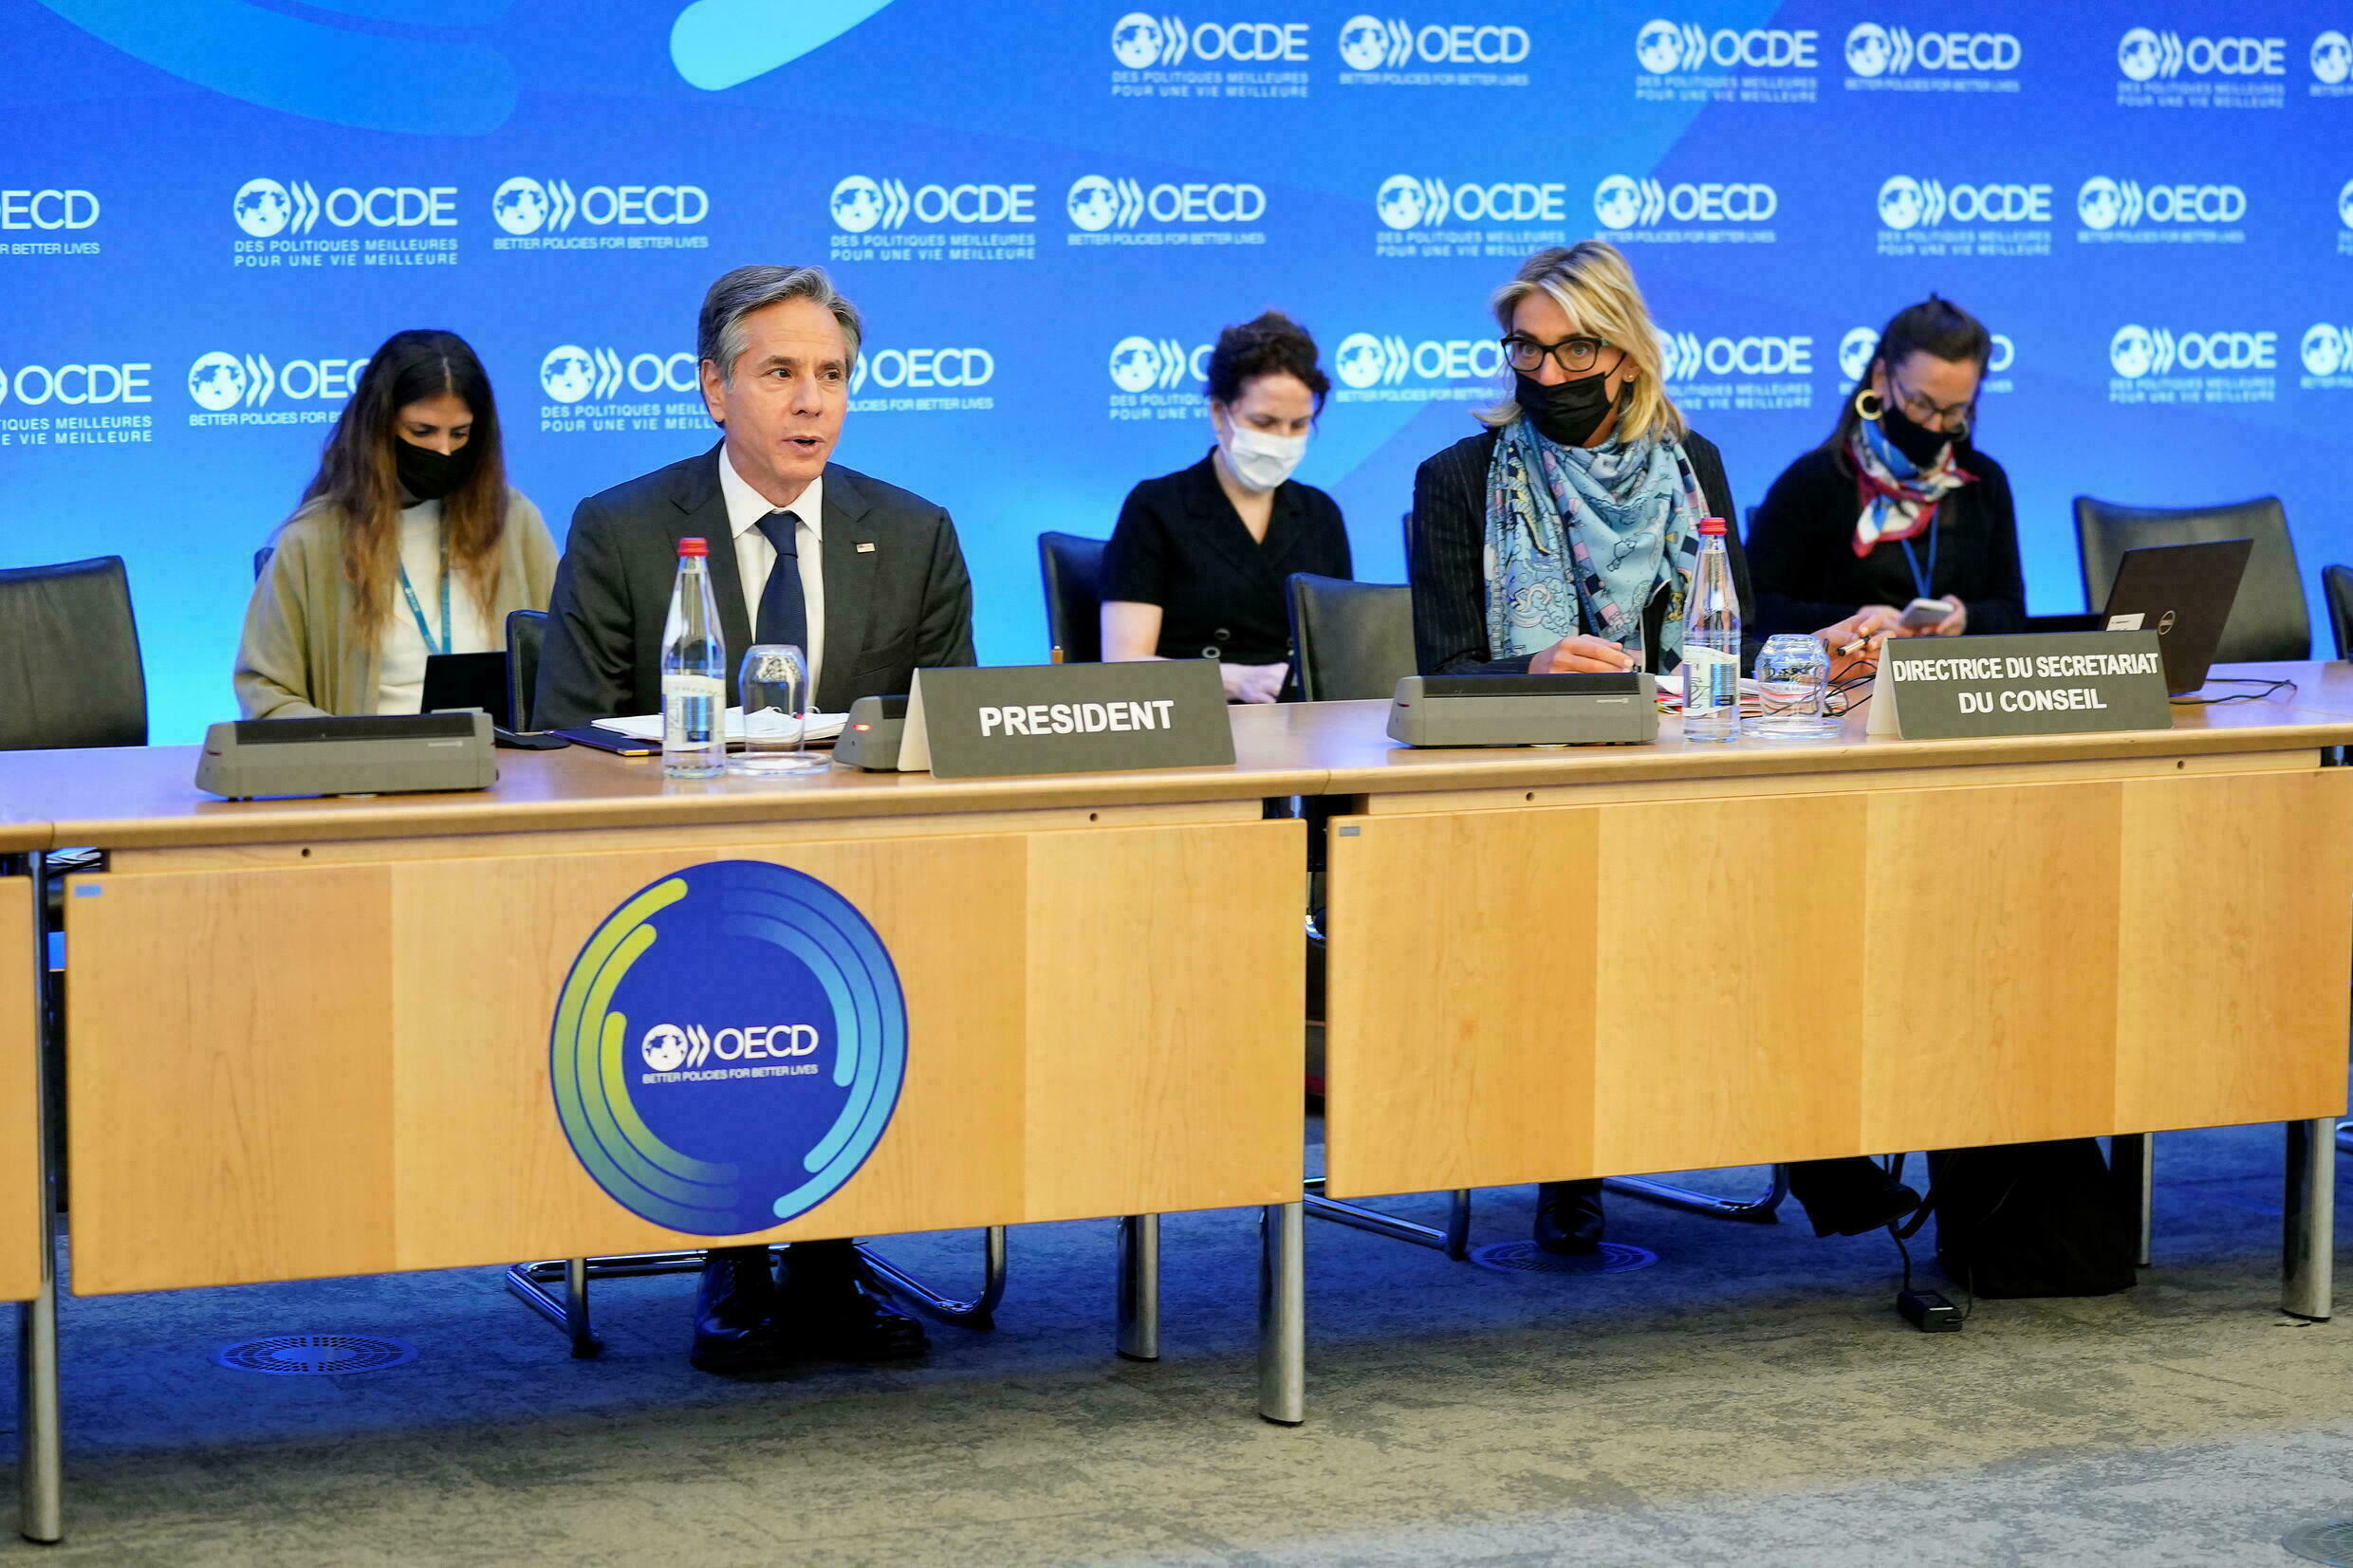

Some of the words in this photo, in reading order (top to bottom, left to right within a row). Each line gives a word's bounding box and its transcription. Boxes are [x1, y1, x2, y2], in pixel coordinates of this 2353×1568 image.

[1193, 23, 1309, 61] OCDE
[1417, 26, 1530, 63] OECD
[1711, 29, 1818, 67] OCDE
[1917, 33, 2021, 70] OECD
[2187, 38, 2286, 74] OCDE
[0, 190, 101, 231] ECD
[325, 188, 457, 227] OCDE
[582, 186, 708, 225] OECD
[915, 185, 1036, 222] OCDE
[1148, 184, 1266, 221] OECD
[1454, 183, 1566, 220] OCDE
[1668, 184, 1776, 220] OECD
[1950, 185, 2051, 220] OCDE
[2147, 186, 2246, 221] OECD
[11, 243, 62, 255] BETTER
[64, 243, 101, 254] LIVES
[234, 241, 265, 252] DES
[269, 241, 360, 251] POLITIQUES
[365, 240, 457, 250] MEILLEURES
[493, 238, 540, 249] BETTER
[542, 238, 598, 249] POLICIES
[600, 237, 625, 248] FOR
[627, 237, 674, 248] BETTER
[676, 237, 709, 248] LIVES
[831, 235, 859, 247] DES
[863, 235, 945, 246] POLITIQUES
[950, 235, 1035, 246] MEILLEURES
[831, 249, 874, 260] POUR
[880, 249, 911, 260] UNE
[918, 249, 941, 259] VIE
[949, 249, 1035, 259] MEILLEURE
[1485, 247, 1533, 255] MEILL
[234, 256, 281, 266] POUR
[288, 255, 322, 266] UNE
[330, 255, 356, 266] VIE
[364, 254, 457, 265] MEILLEURE
[873, 349, 993, 387] OECD
[1705, 338, 1812, 374] OCDE
[2178, 333, 2276, 368] OCDE
[14, 364, 152, 404] OCDE
[280, 358, 371, 399] OEC
[627, 352, 700, 393] OC
[542, 406, 570, 417] DES
[575, 405, 660, 415] POLITIQUES
[666, 405, 707, 415] MEILL
[848, 401, 887, 411] OLICIES
[890, 399, 913, 410] FOR
[916, 398, 959, 410] BETTER
[962, 397, 994, 409] LIVES
[1109, 395, 1137, 406] DES
[1109, 409, 1152, 419] POUR
[1158, 408, 1187, 418] UNE
[2, 419, 49, 430] IQUES
[56, 417, 152, 428] MEILLEURES
[190, 415, 238, 425] BETTER
[240, 413, 298, 424] POLICIES
[300, 412, 326, 422] FOR
[542, 420, 585, 431] POUR
[593, 419, 624, 431] UNE
[633, 418, 658, 430] VIE
[665, 419, 712, 429] MEILL
[20, 434, 46, 444] VIE
[55, 432, 152, 443] MEILLEURE
[1892, 657, 2004, 682] DIRECTRICE
[2007, 656, 2033, 679] DU
[2037, 653, 2158, 677] SECRETARIAT
[978, 699, 1175, 737] PRESIDENT
[1958, 692, 1993, 714] DU
[1999, 688, 2107, 712] CONSEIL
[713, 1024, 820, 1061] OECD
[642, 1071, 681, 1085] BETTER
[682, 1069, 728, 1082] POLICIES
[729, 1067, 750, 1079] FOR
[750, 1065, 789, 1079] BETTER
[790, 1063, 819, 1077] LIVES
